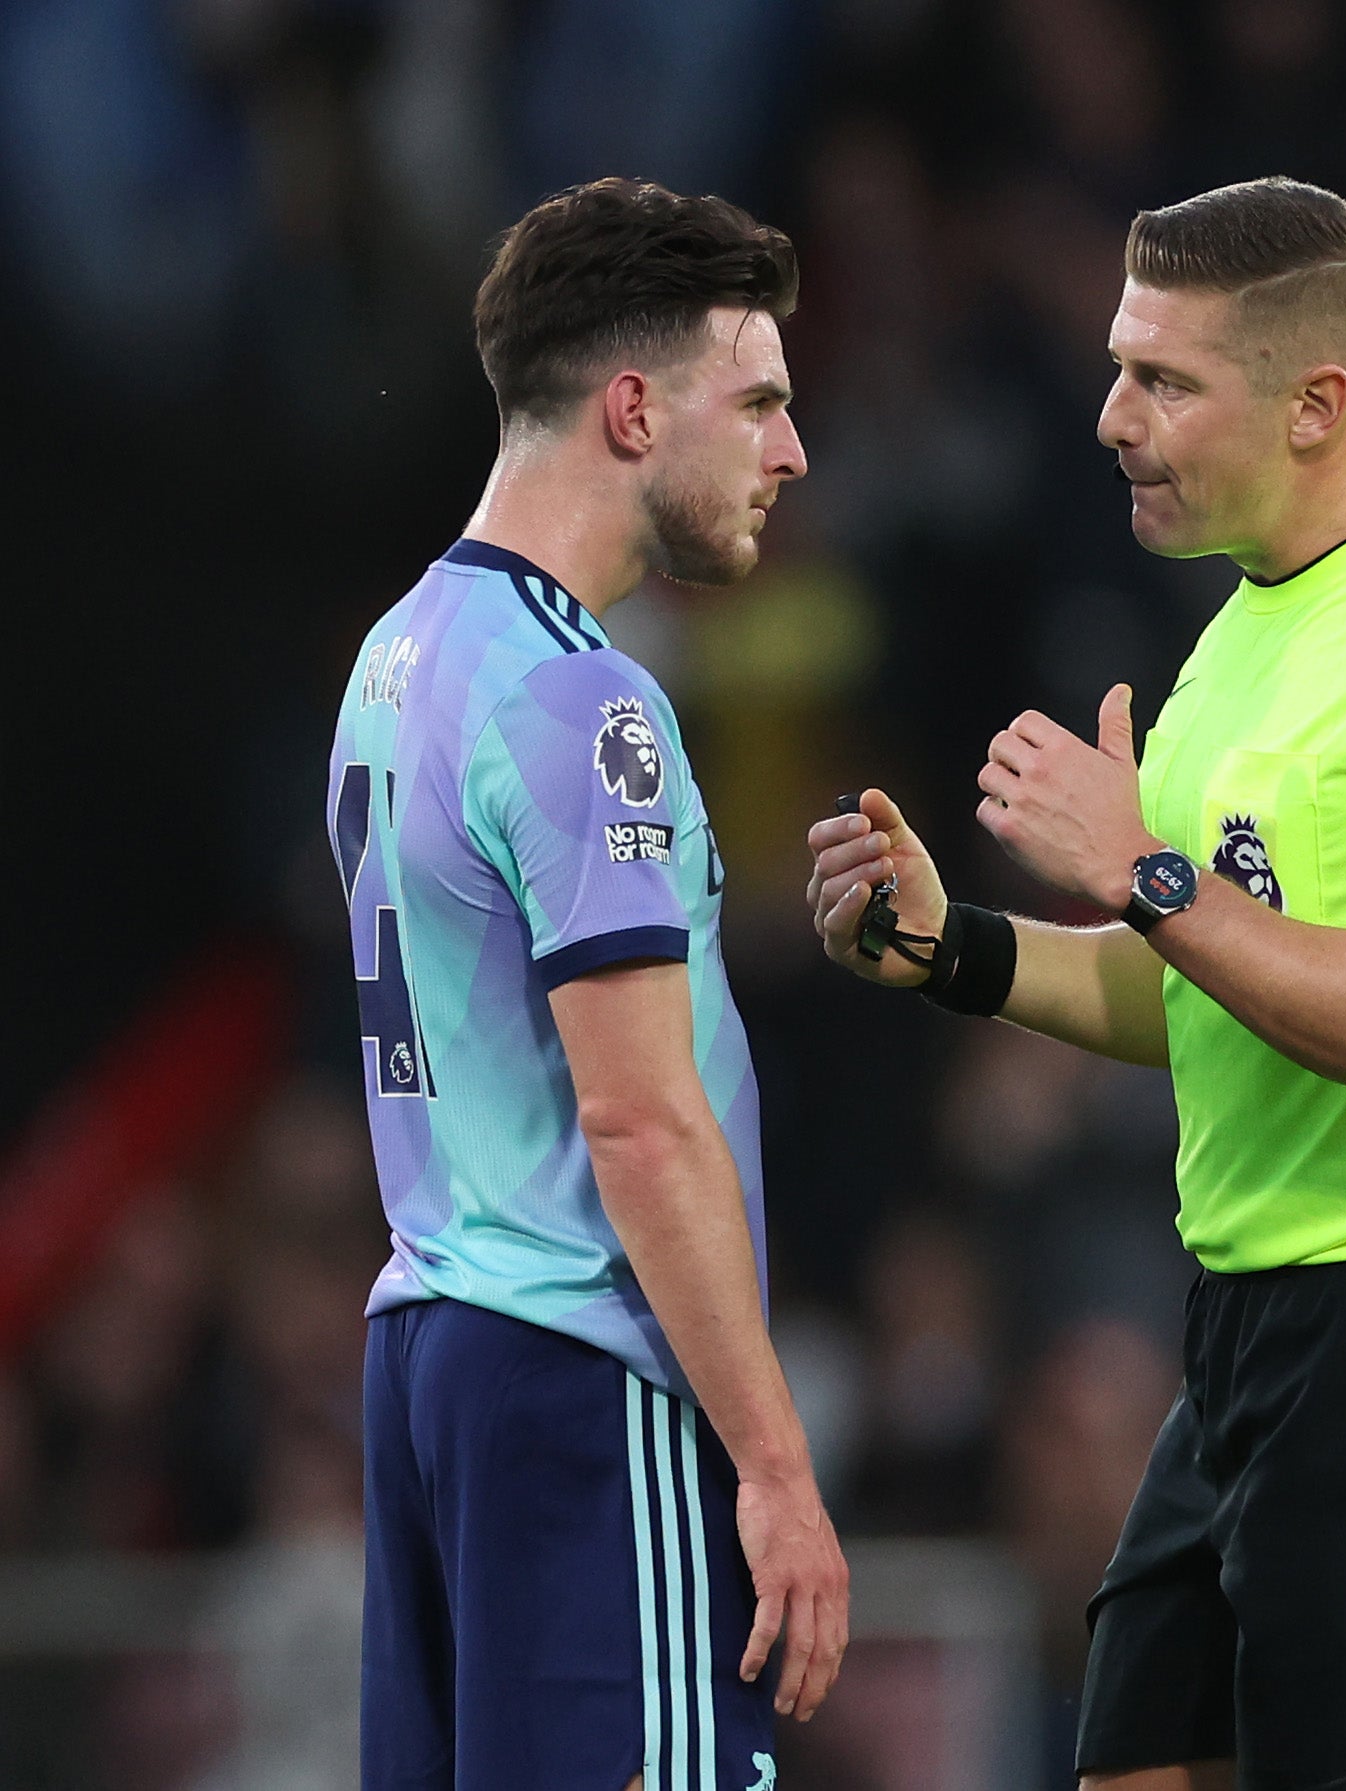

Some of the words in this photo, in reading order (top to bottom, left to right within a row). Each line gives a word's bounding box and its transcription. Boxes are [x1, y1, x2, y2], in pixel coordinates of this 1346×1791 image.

[360, 635, 421, 716] RICE
[604, 824, 636, 845] No
[608, 843, 637, 862] for
[333, 761, 438, 1103] 4
